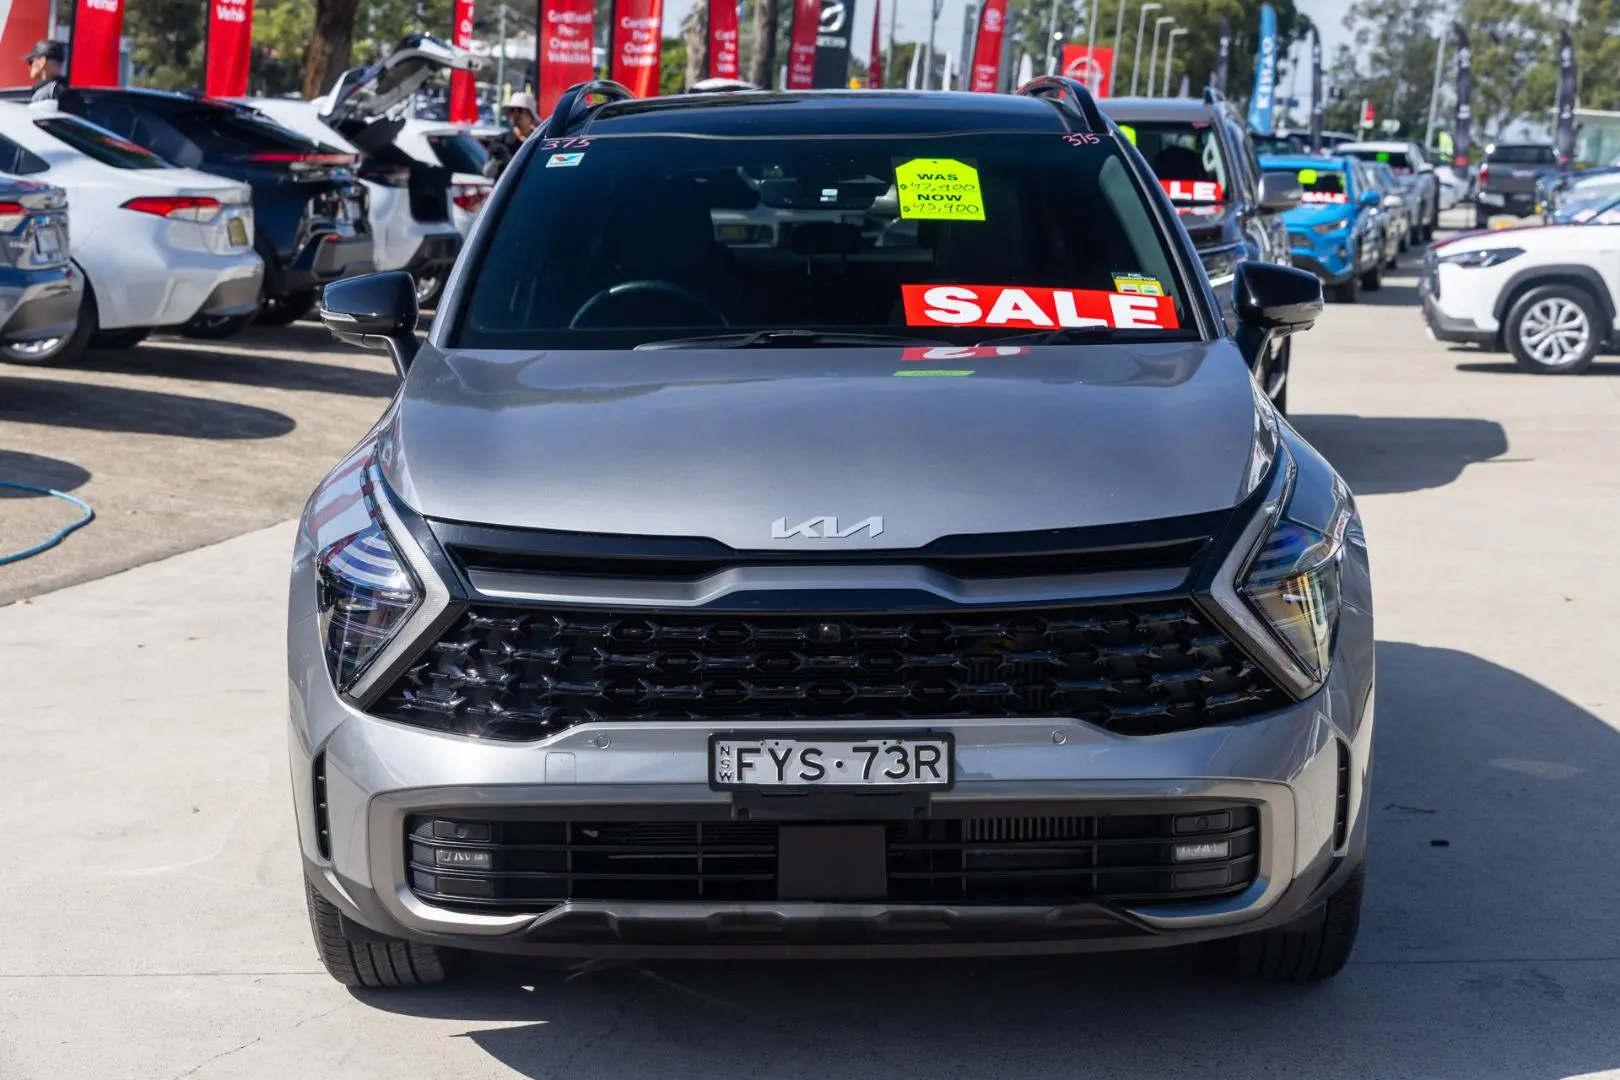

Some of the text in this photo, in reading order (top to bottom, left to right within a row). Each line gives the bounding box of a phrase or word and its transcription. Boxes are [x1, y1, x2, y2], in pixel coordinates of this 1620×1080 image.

[550, 37, 590, 50] Owned
[916, 173, 959, 181] WAS
[917, 193, 963, 202] NOW
[1169, 180, 1217, 201] LE
[923, 286, 1164, 329] SALE
[771, 516, 885, 539] KIA
